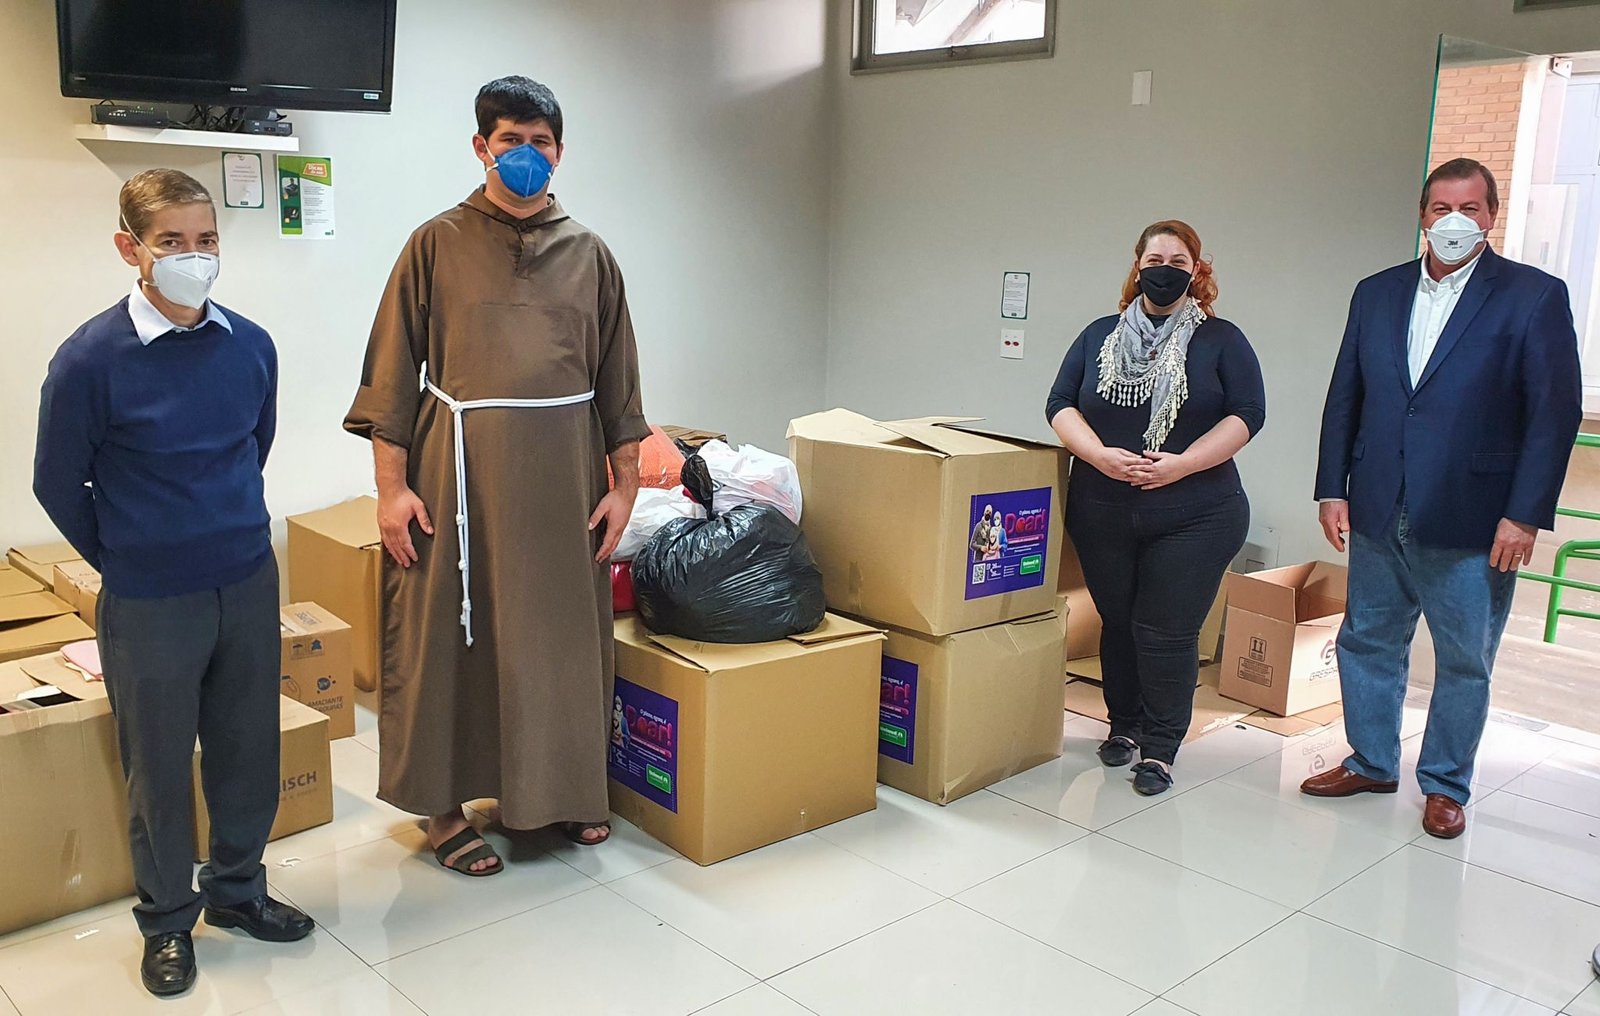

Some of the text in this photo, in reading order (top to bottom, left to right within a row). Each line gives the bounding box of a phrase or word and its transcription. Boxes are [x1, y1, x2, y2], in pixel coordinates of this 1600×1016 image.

[1004, 508, 1046, 534] Doar!
[880, 682, 911, 705] ar!
[625, 704, 673, 747] Doar!
[280, 770, 318, 792] ISCH
